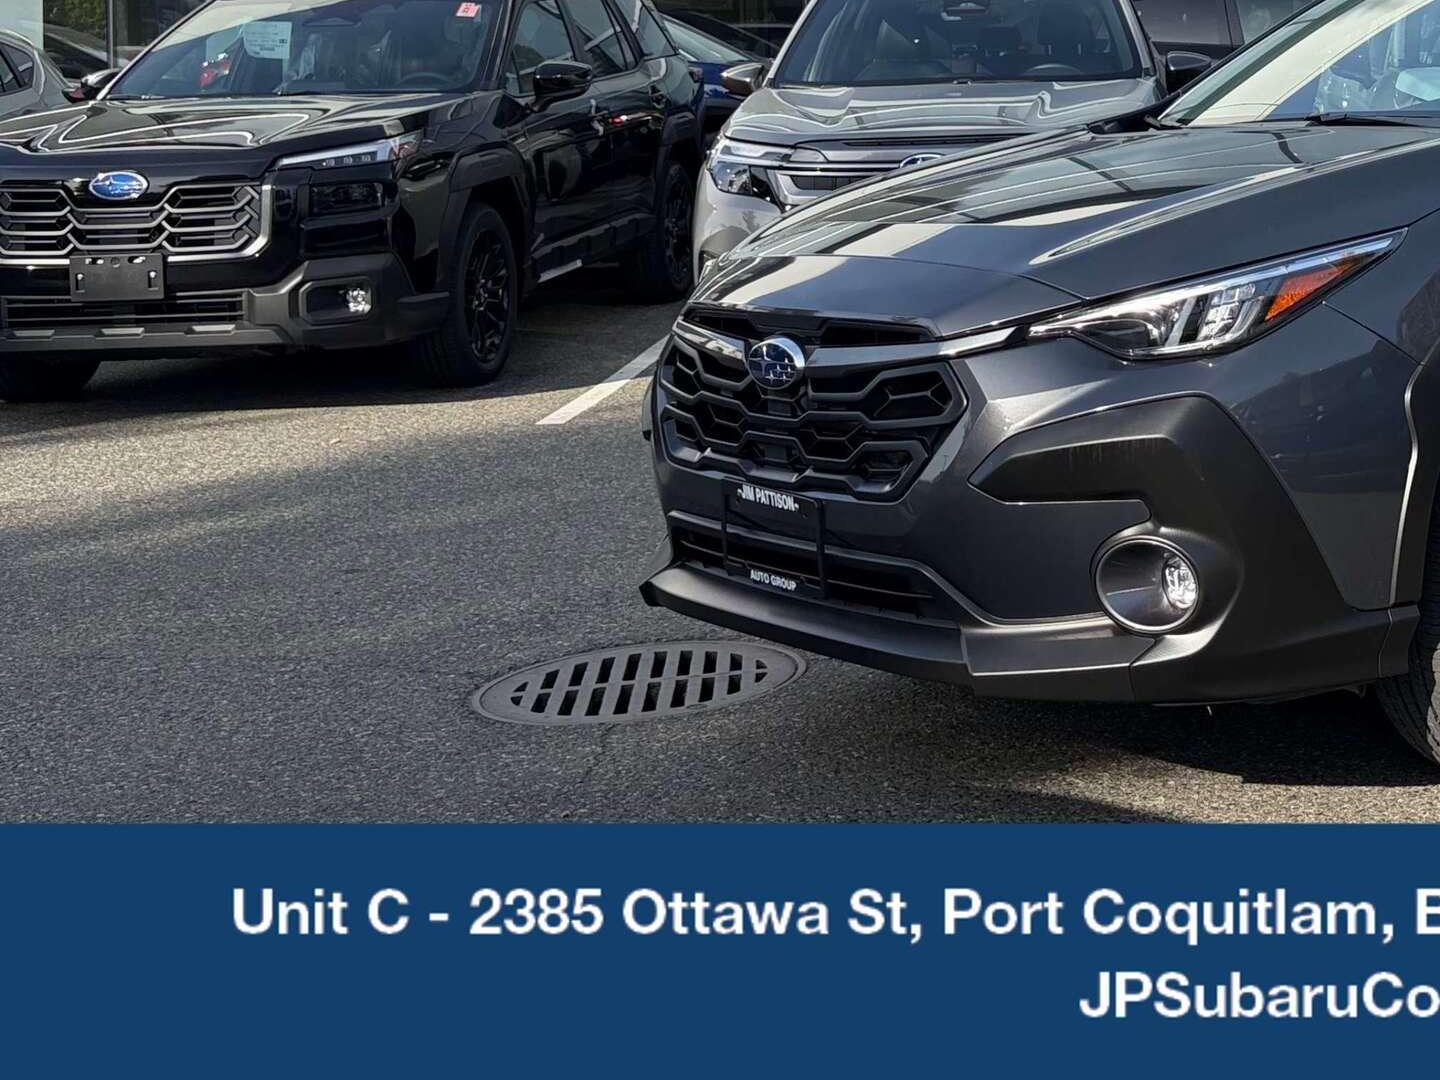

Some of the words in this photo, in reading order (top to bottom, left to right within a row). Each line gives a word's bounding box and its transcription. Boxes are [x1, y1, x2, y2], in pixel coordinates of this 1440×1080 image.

[742, 484, 756, 501] JIM
[755, 488, 796, 512] PATTISON
[750, 569, 770, 584] AUTO
[770, 575, 797, 591] GROUP
